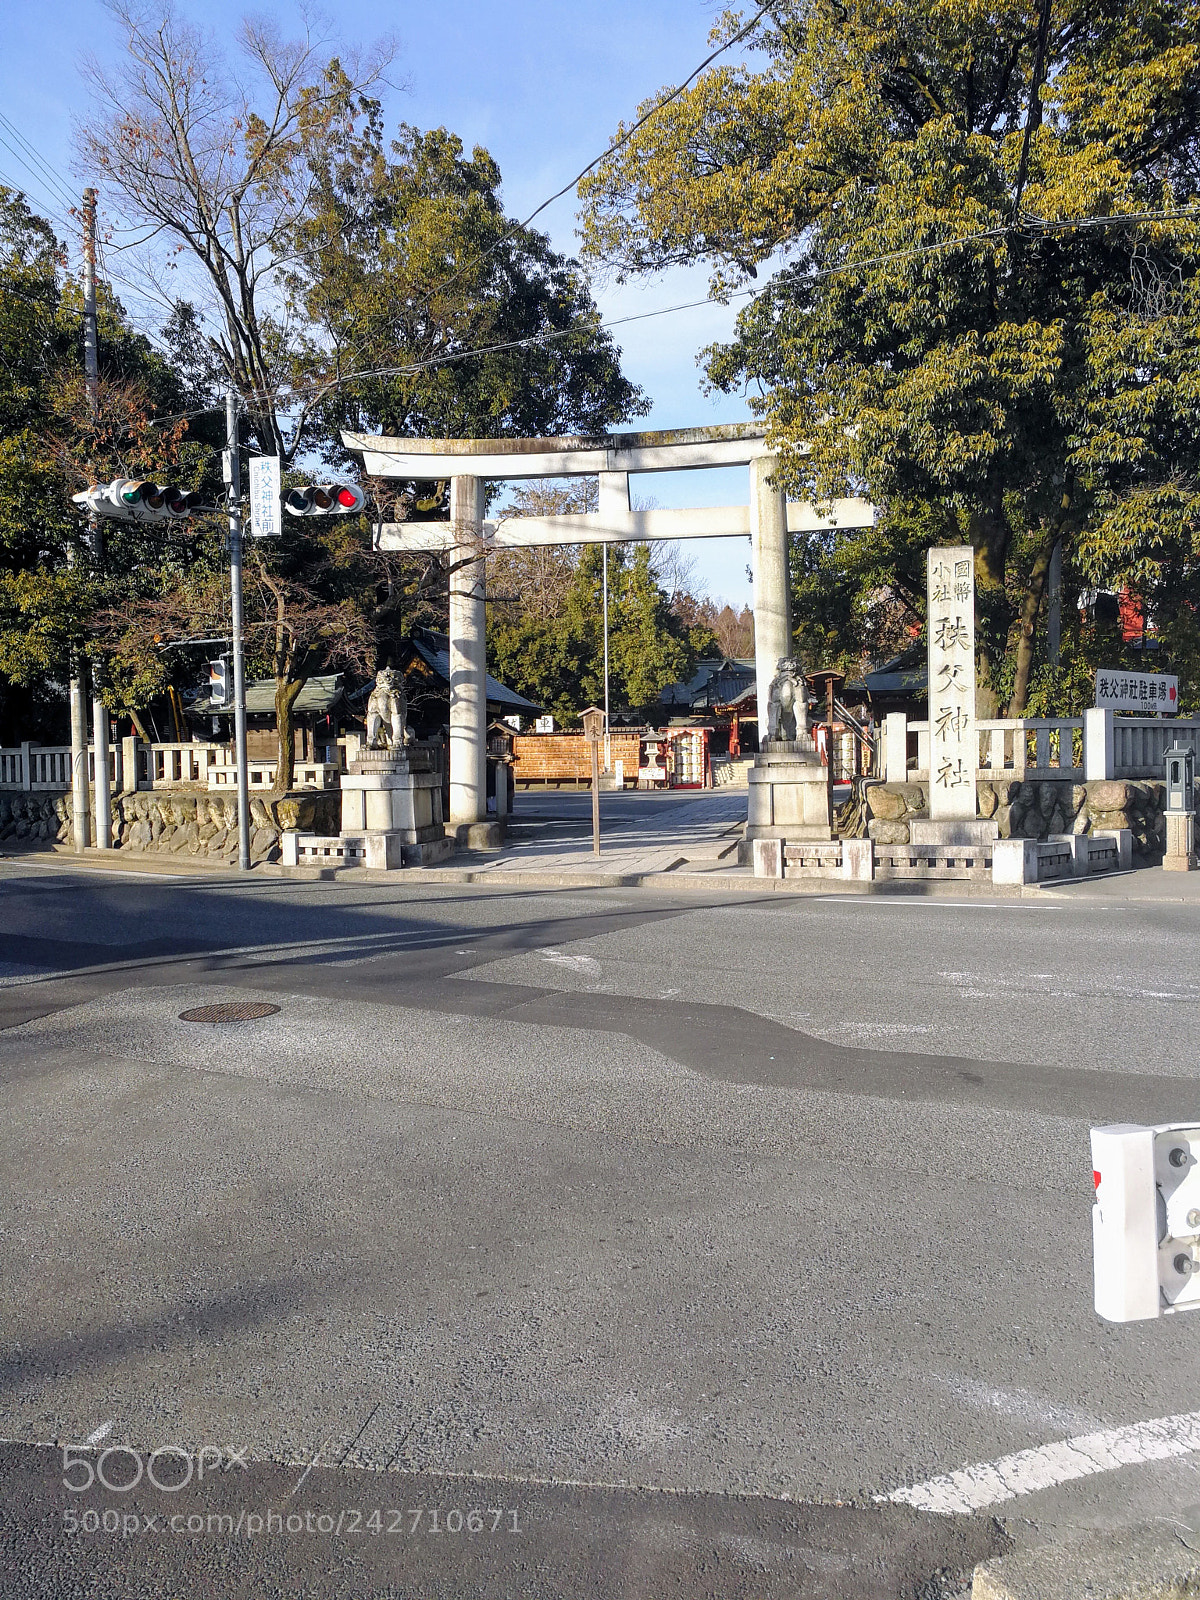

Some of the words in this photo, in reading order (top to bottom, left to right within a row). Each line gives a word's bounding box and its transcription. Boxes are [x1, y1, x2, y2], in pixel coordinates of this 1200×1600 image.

[261, 461, 274, 532] 秩父神社前
[932, 561, 952, 602] 小社
[934, 616, 972, 788] 秩父神社
[1099, 677, 1168, 701] 秩父神社駐車場
